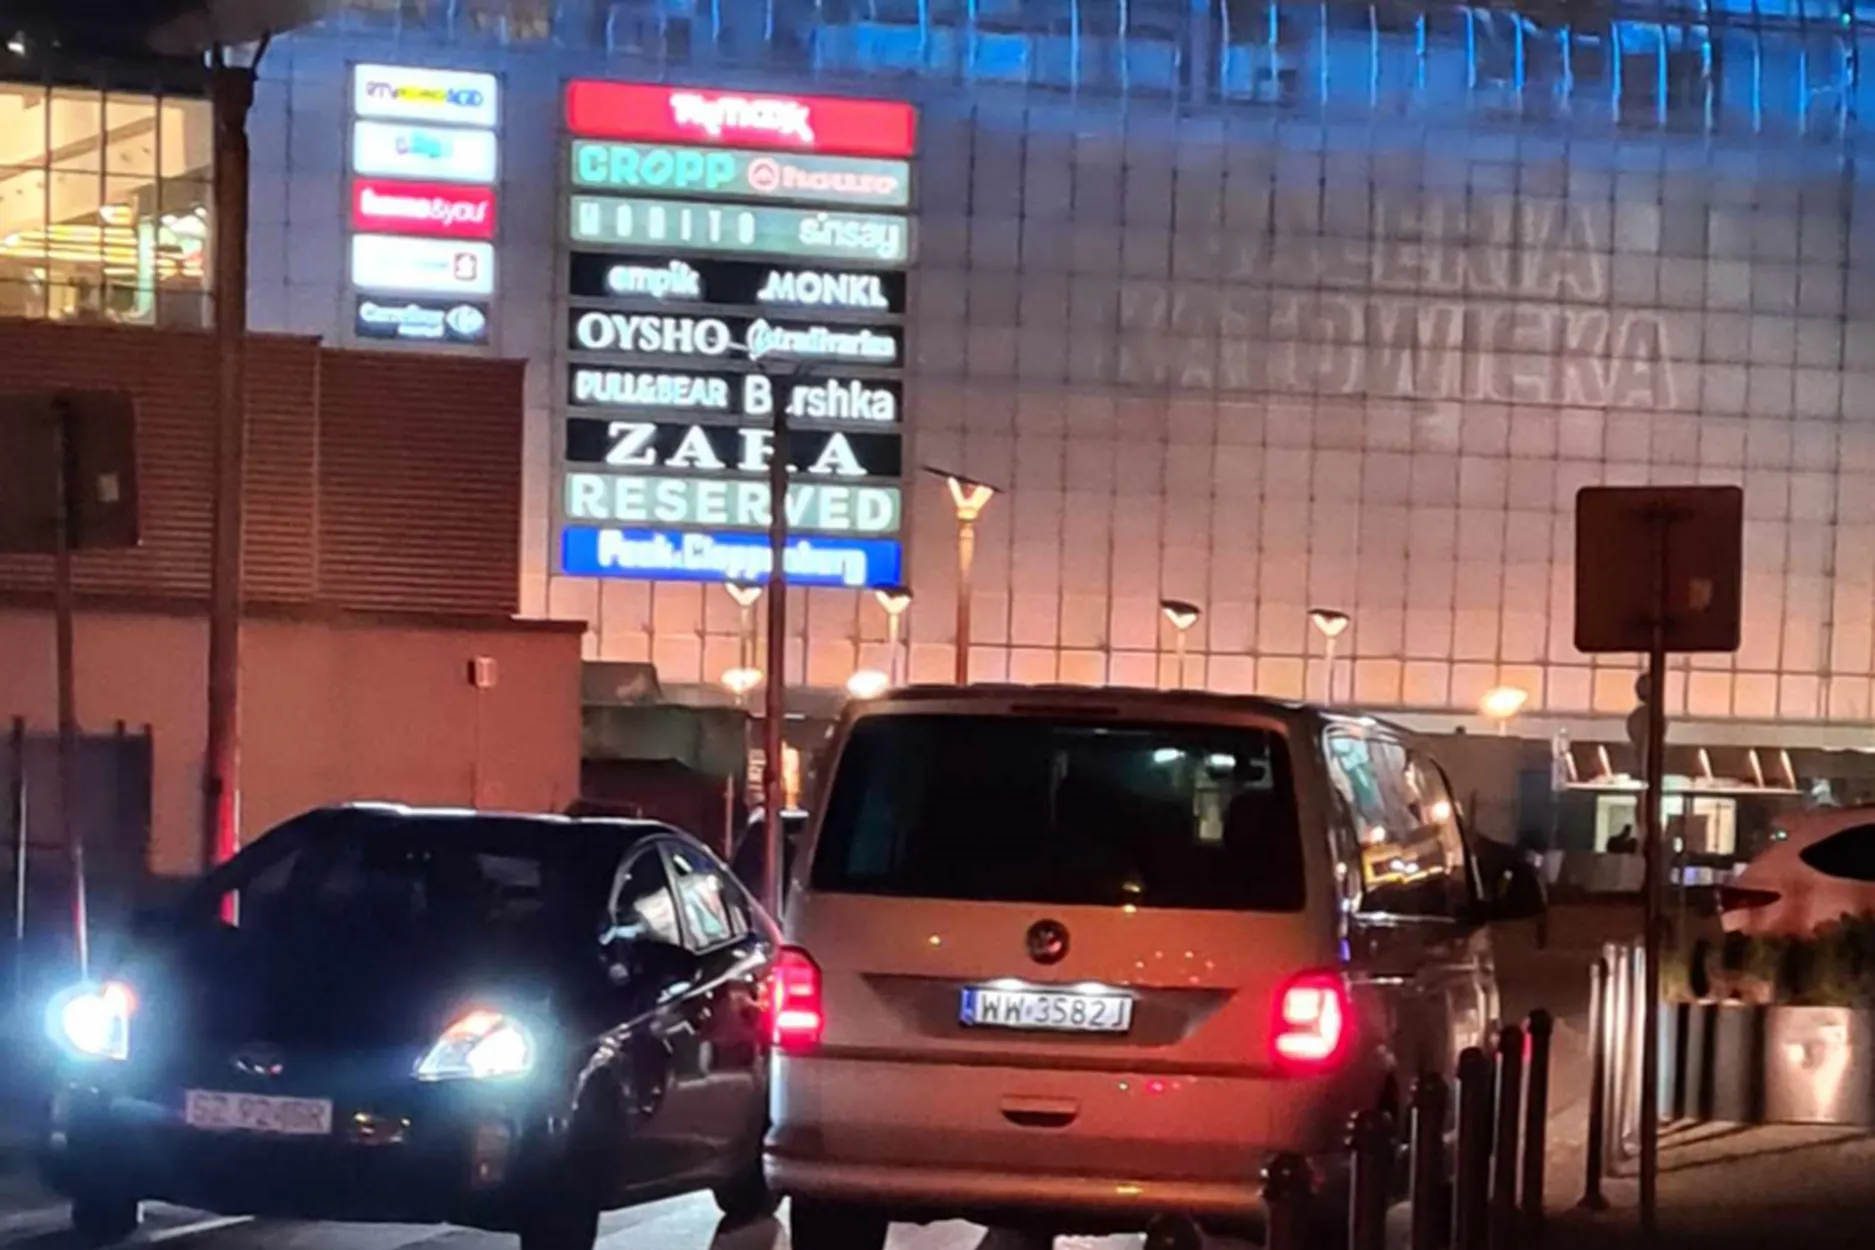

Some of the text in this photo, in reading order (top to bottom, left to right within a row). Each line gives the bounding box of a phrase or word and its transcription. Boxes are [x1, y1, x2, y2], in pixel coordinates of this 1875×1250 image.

[579, 145, 736, 190] CROPP
[576, 313, 731, 355] OYSHO
[744, 374, 895, 421] Brshka
[571, 475, 893, 531] RESERVED
[981, 993, 1024, 1022] WW
